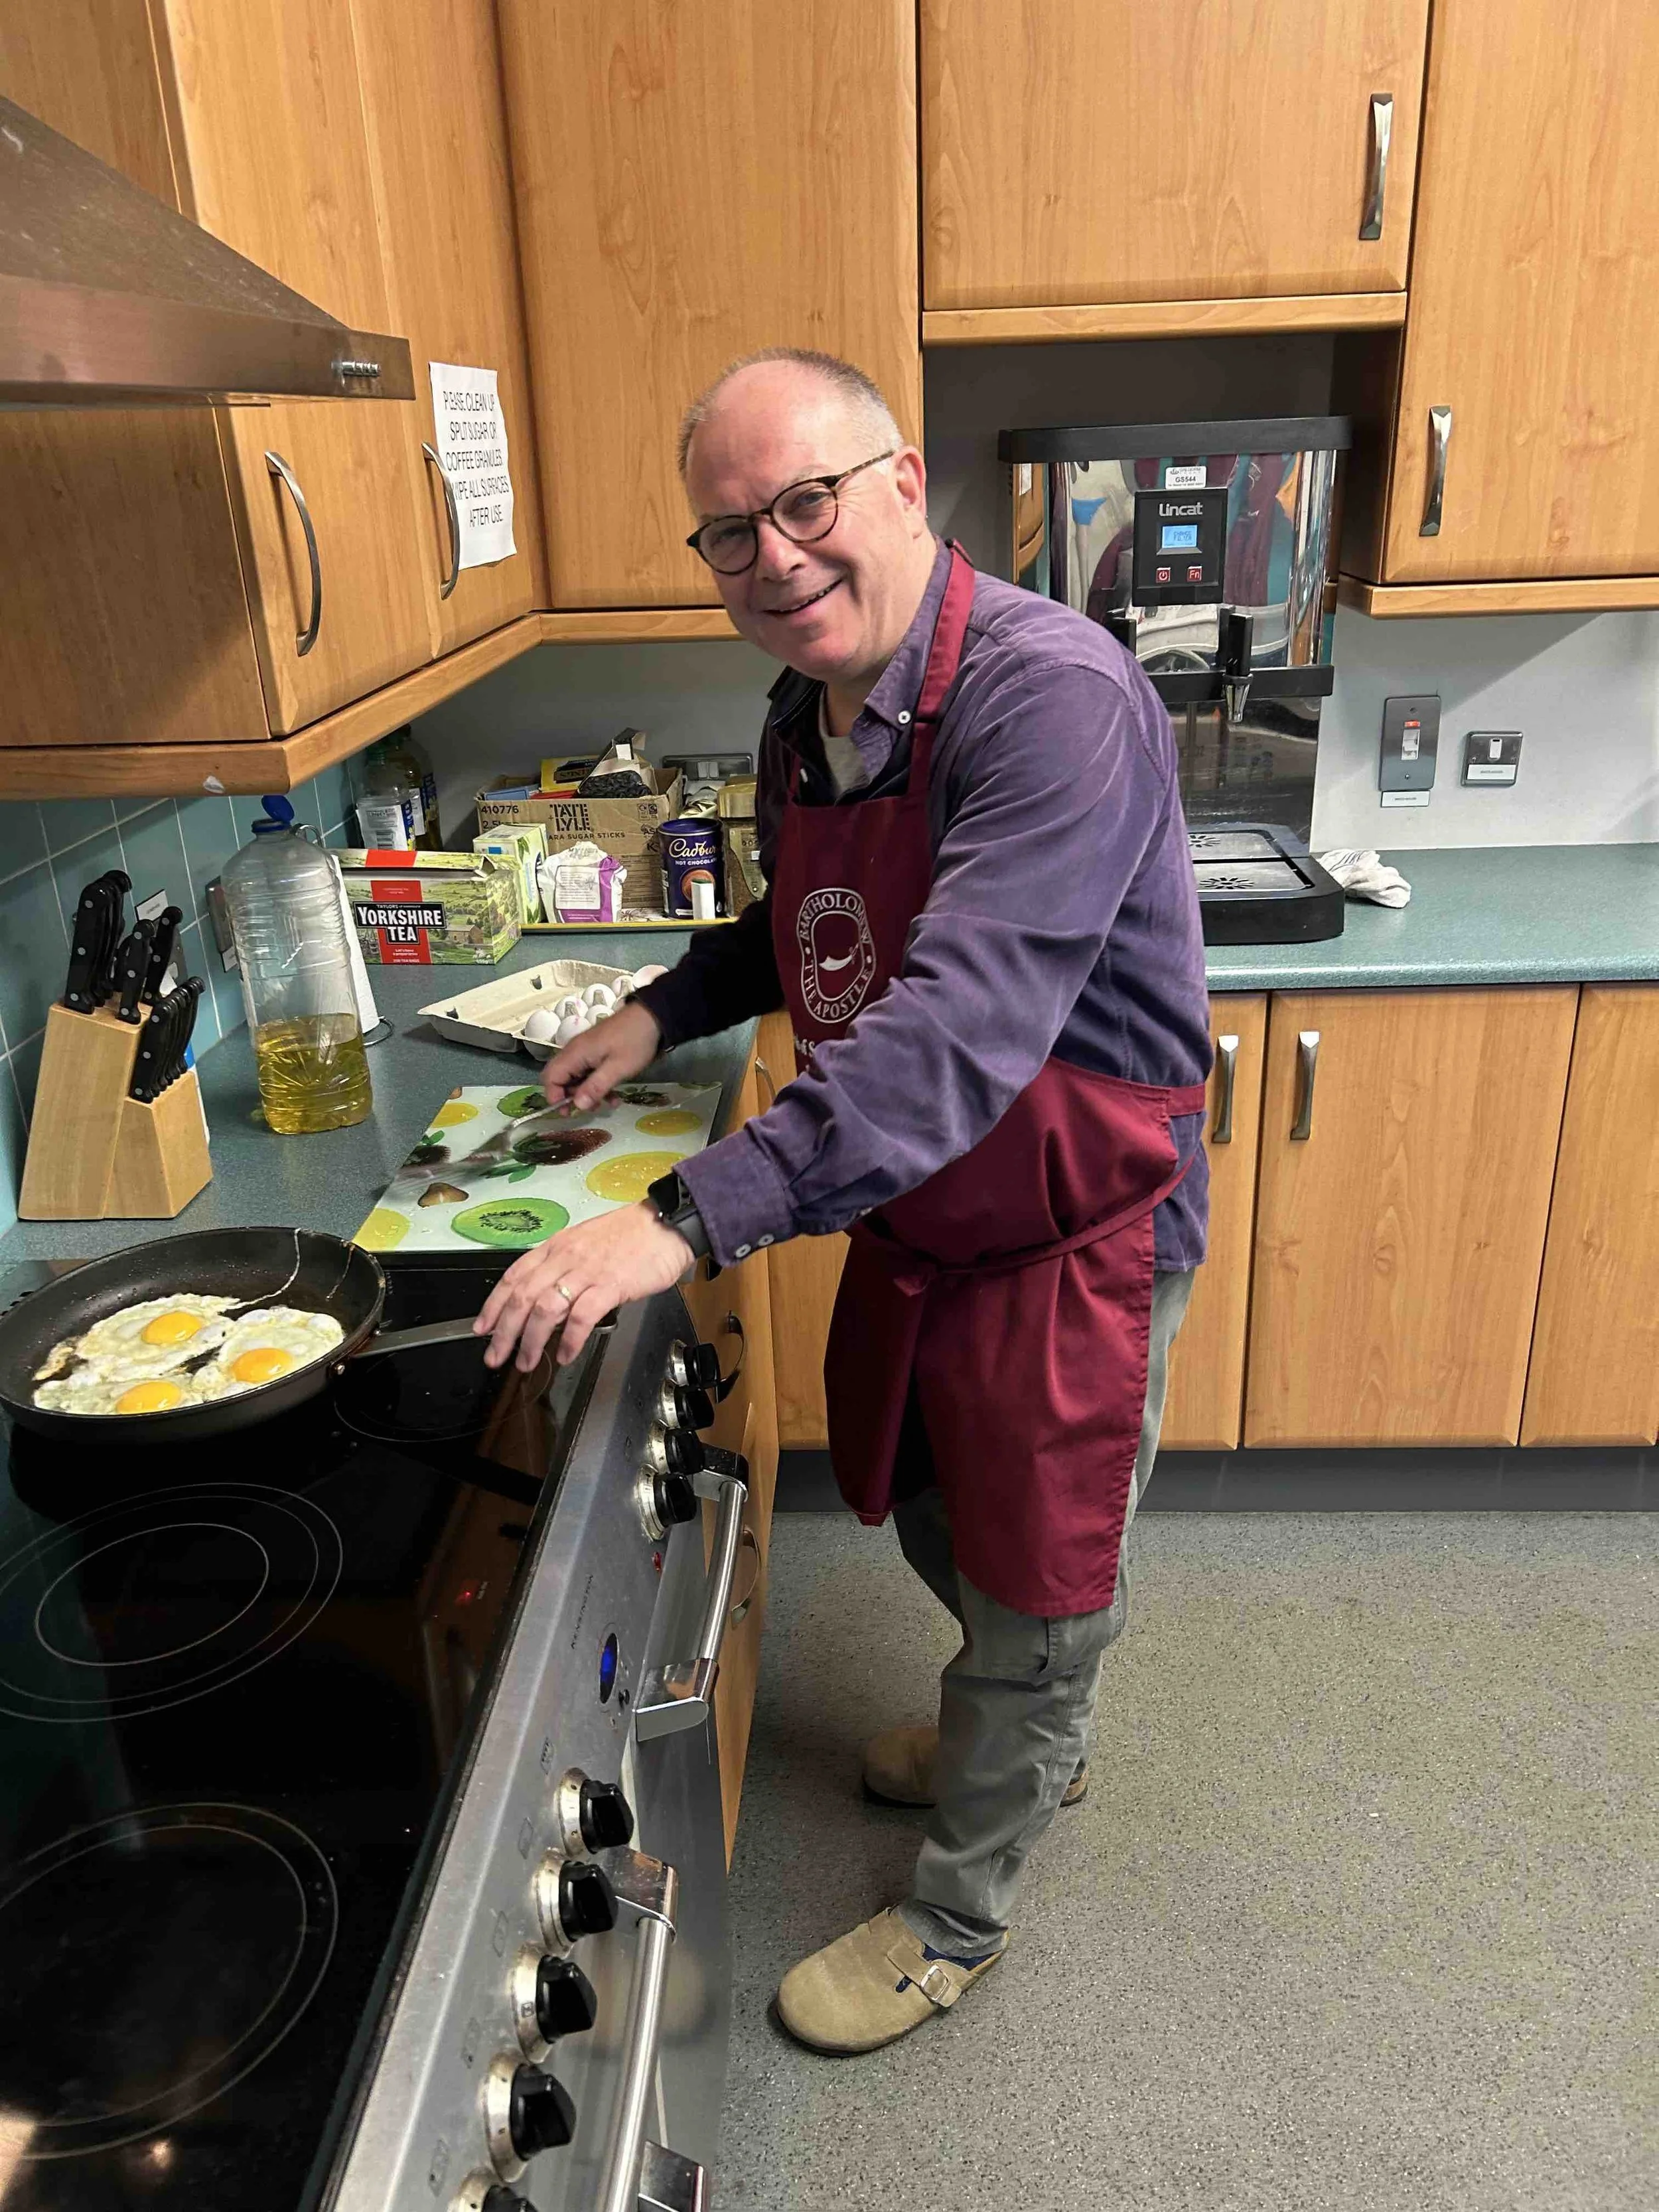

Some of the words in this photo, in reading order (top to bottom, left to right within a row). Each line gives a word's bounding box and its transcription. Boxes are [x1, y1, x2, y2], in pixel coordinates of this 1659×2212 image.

[443, 391, 466, 411] PLEASE
[466, 392, 487, 411] CLEAN
[487, 394, 495, 411] UP
[468, 421, 490, 440] SUGAR
[489, 421, 497, 439] OR
[446, 451, 474, 471] COFFEE
[469, 479, 482, 498] ALL
[481, 476, 510, 496] SURFACES
[470, 507, 490, 528] AFTER
[1189, 569, 1200, 579] Fn
[480, 805, 519, 814] 410776
[549, 804, 589, 817] TATE
[555, 818, 590, 831] LYLE
[357, 907, 443, 925] YORKSHIRE
[388, 926, 417, 941] TEA
[804, 960, 816, 1003] THE
[814, 969, 872, 1018] APOSTLE
